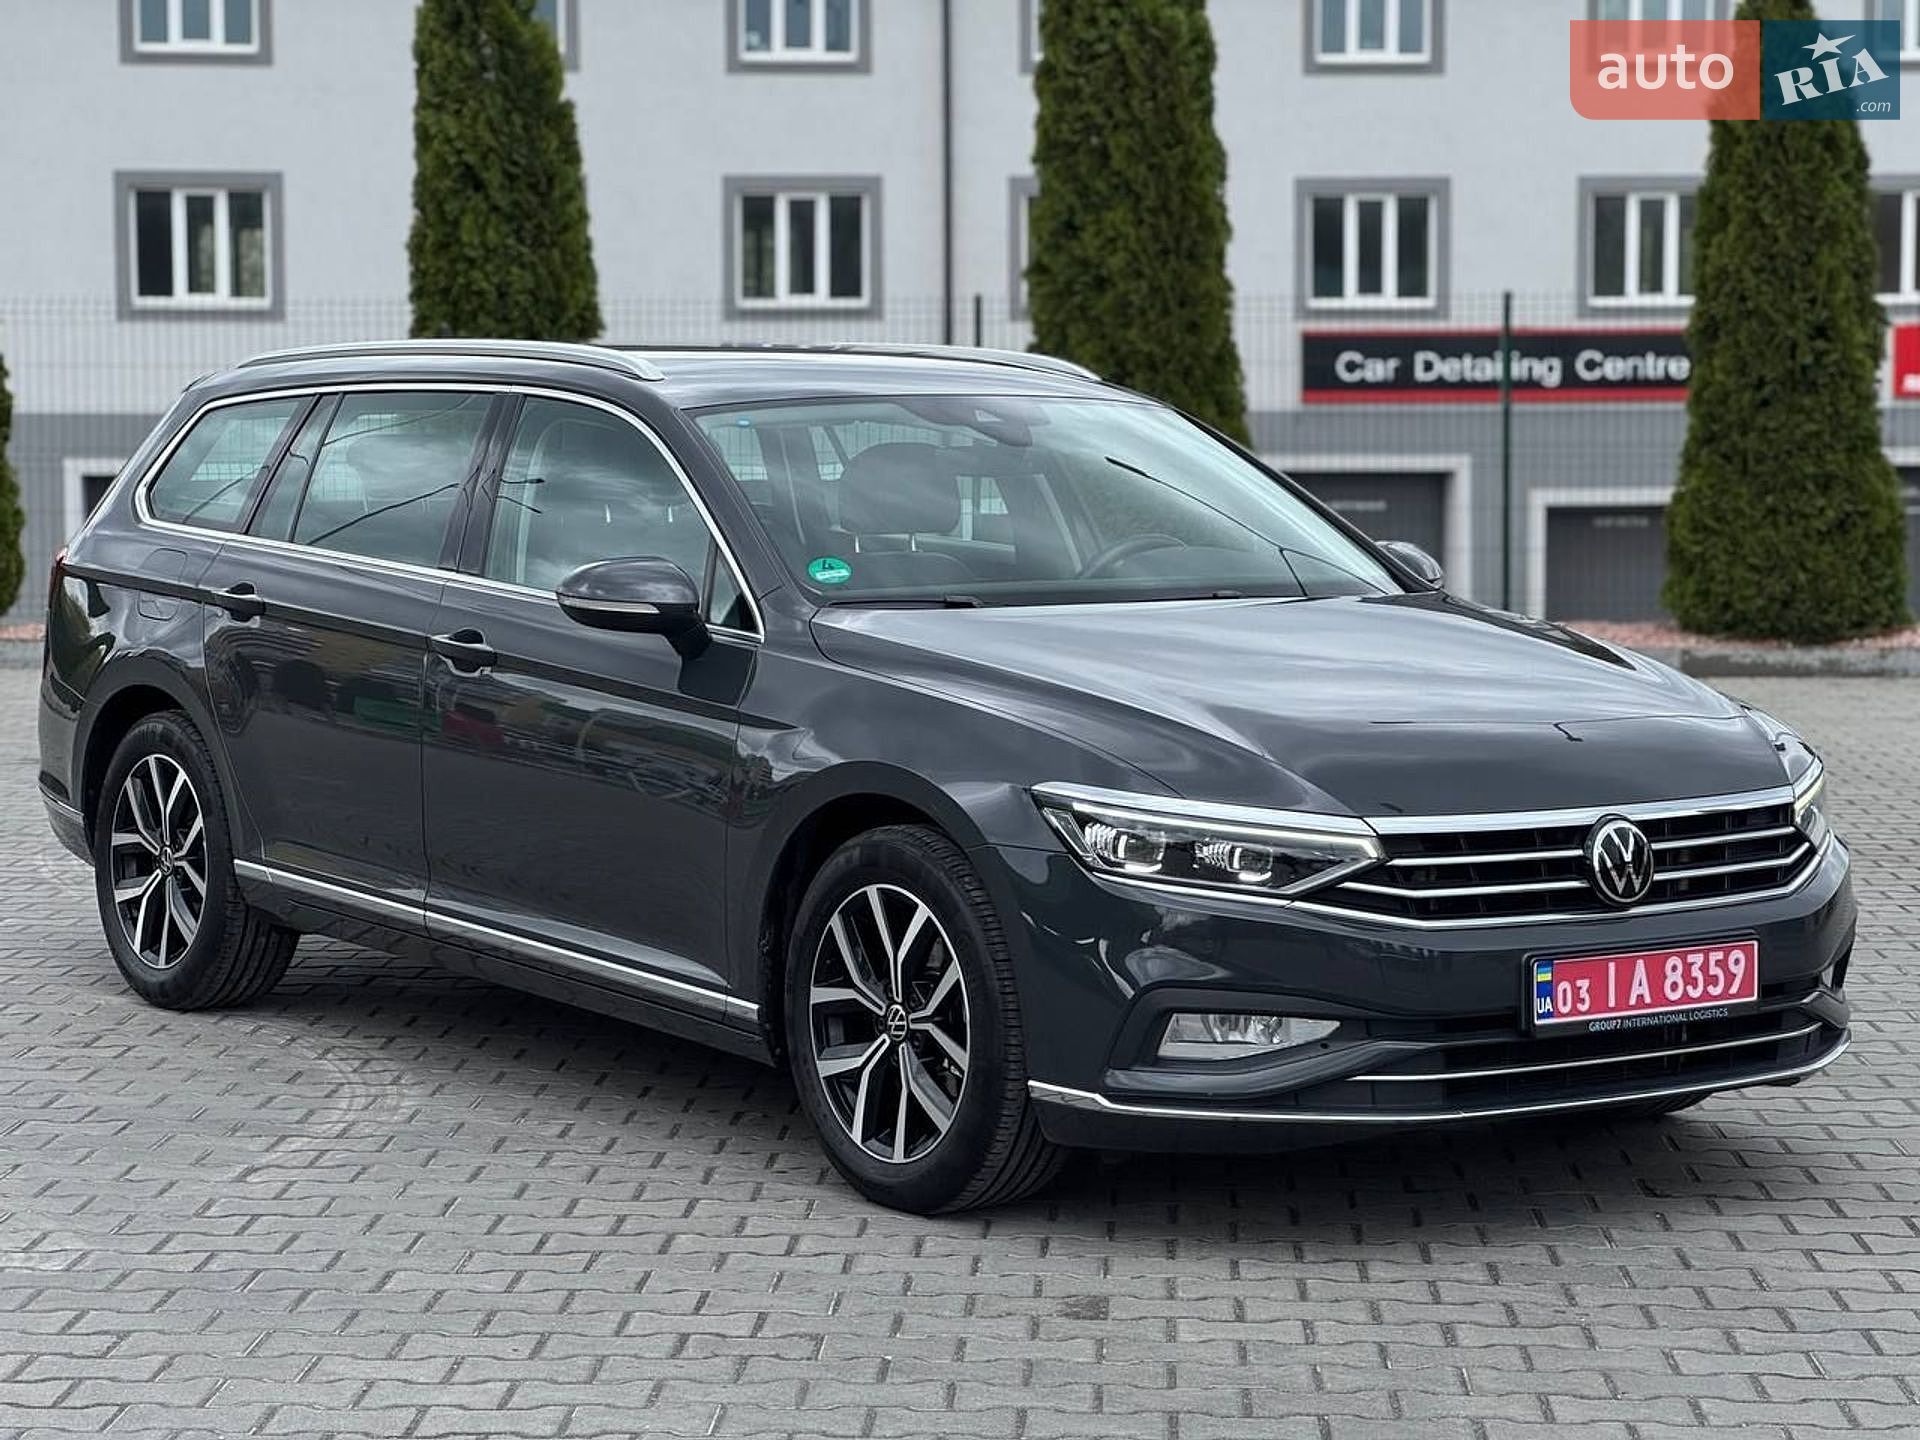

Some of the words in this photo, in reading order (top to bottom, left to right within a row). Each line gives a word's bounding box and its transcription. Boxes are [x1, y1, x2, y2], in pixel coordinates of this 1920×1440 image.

[1335, 350, 1400, 383] Car
[1413, 350, 1563, 388] Detaiing
[1574, 349, 1691, 382] Centre
[1556, 978, 1591, 1014] 03
[1607, 958, 1651, 1008] IA
[1662, 949, 1746, 1002] 8359
[1537, 996, 1554, 1015] UA
[1622, 1012, 1688, 1028] INTERNATIONAL
[1688, 1007, 1729, 1021] LOGISTICS
